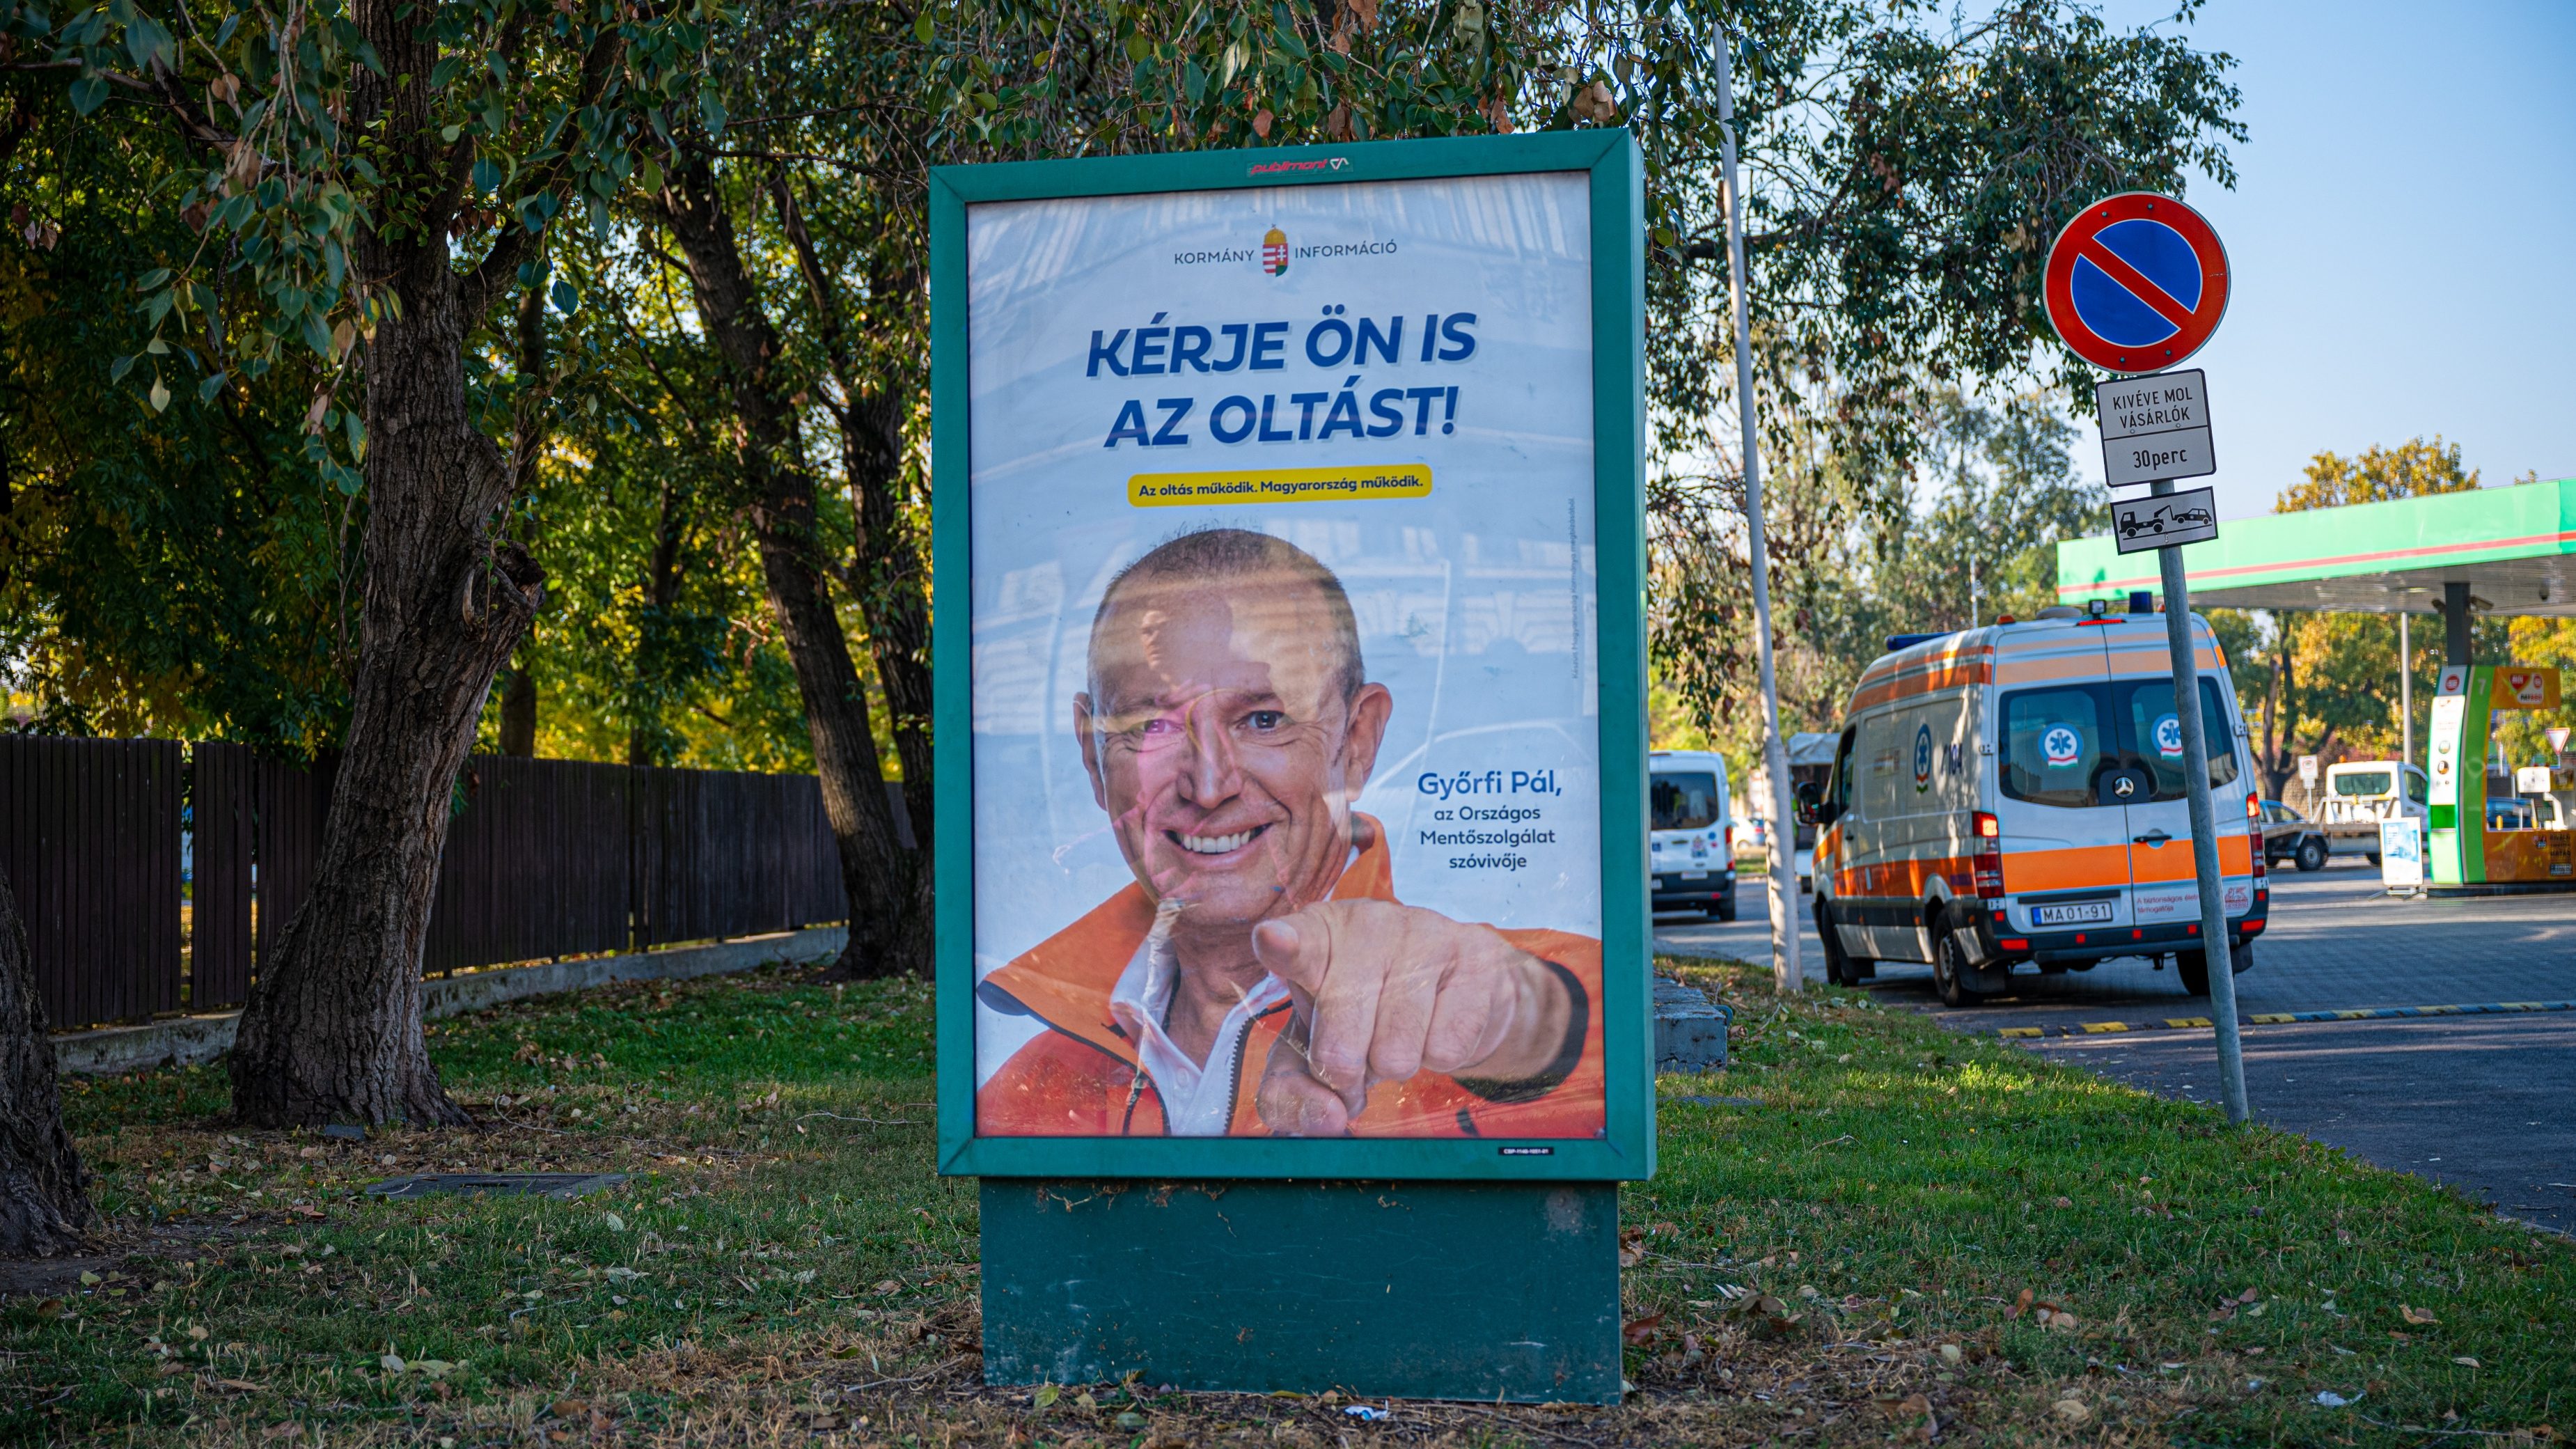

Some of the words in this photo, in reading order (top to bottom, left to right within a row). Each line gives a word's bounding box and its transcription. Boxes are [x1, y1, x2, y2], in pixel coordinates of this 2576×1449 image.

[1175, 248, 1255, 265] KORMÁNY
[1295, 239, 1397, 258] INFORMÁCIÓ
[1086, 311, 1289, 377] KÉRJE
[1305, 304, 1404, 368] ÖN
[1420, 312, 1477, 363] IS
[2113, 390, 2160, 409] KIVÉVE
[2164, 387, 2192, 402] MOL
[1103, 397, 1193, 448] AZ
[1209, 375, 1459, 444] OLTÁST!
[2119, 405, 2190, 428] VÁSÁRLÓK
[2133, 448, 2188, 471] 30perc
[1139, 485, 1156, 497] Az
[1159, 483, 1193, 496] oltás
[1197, 480, 1258, 495] működik.
[1261, 478, 1357, 495] Magyarország
[1361, 475, 1424, 489] működik.
[2477, 679, 2487, 695] 7
[1417, 771, 1502, 801] Győrfi
[1511, 769, 1562, 797] Pál,
[1434, 809, 1454, 820] az
[1459, 805, 1541, 823] Országos
[1420, 829, 1556, 847] Mentőszolgálat
[1449, 852, 1527, 871] szóvivője
